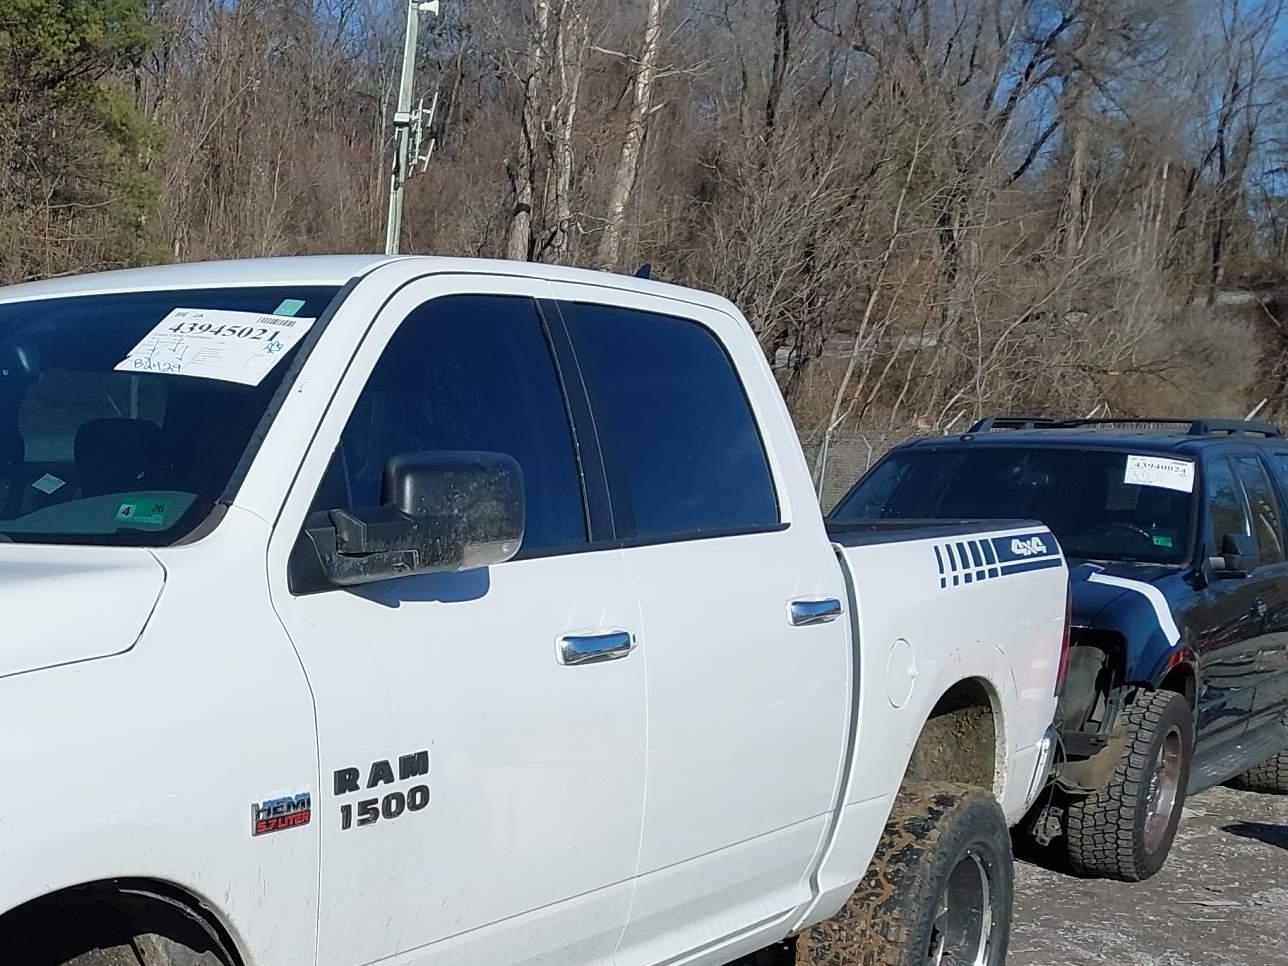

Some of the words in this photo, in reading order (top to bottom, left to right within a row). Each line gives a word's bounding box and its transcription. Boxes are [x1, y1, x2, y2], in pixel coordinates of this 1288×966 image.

[168, 321, 281, 342] 43945021
[333, 750, 429, 796] RAM
[251, 791, 311, 822] HEMI
[340, 784, 430, 830] 1500
